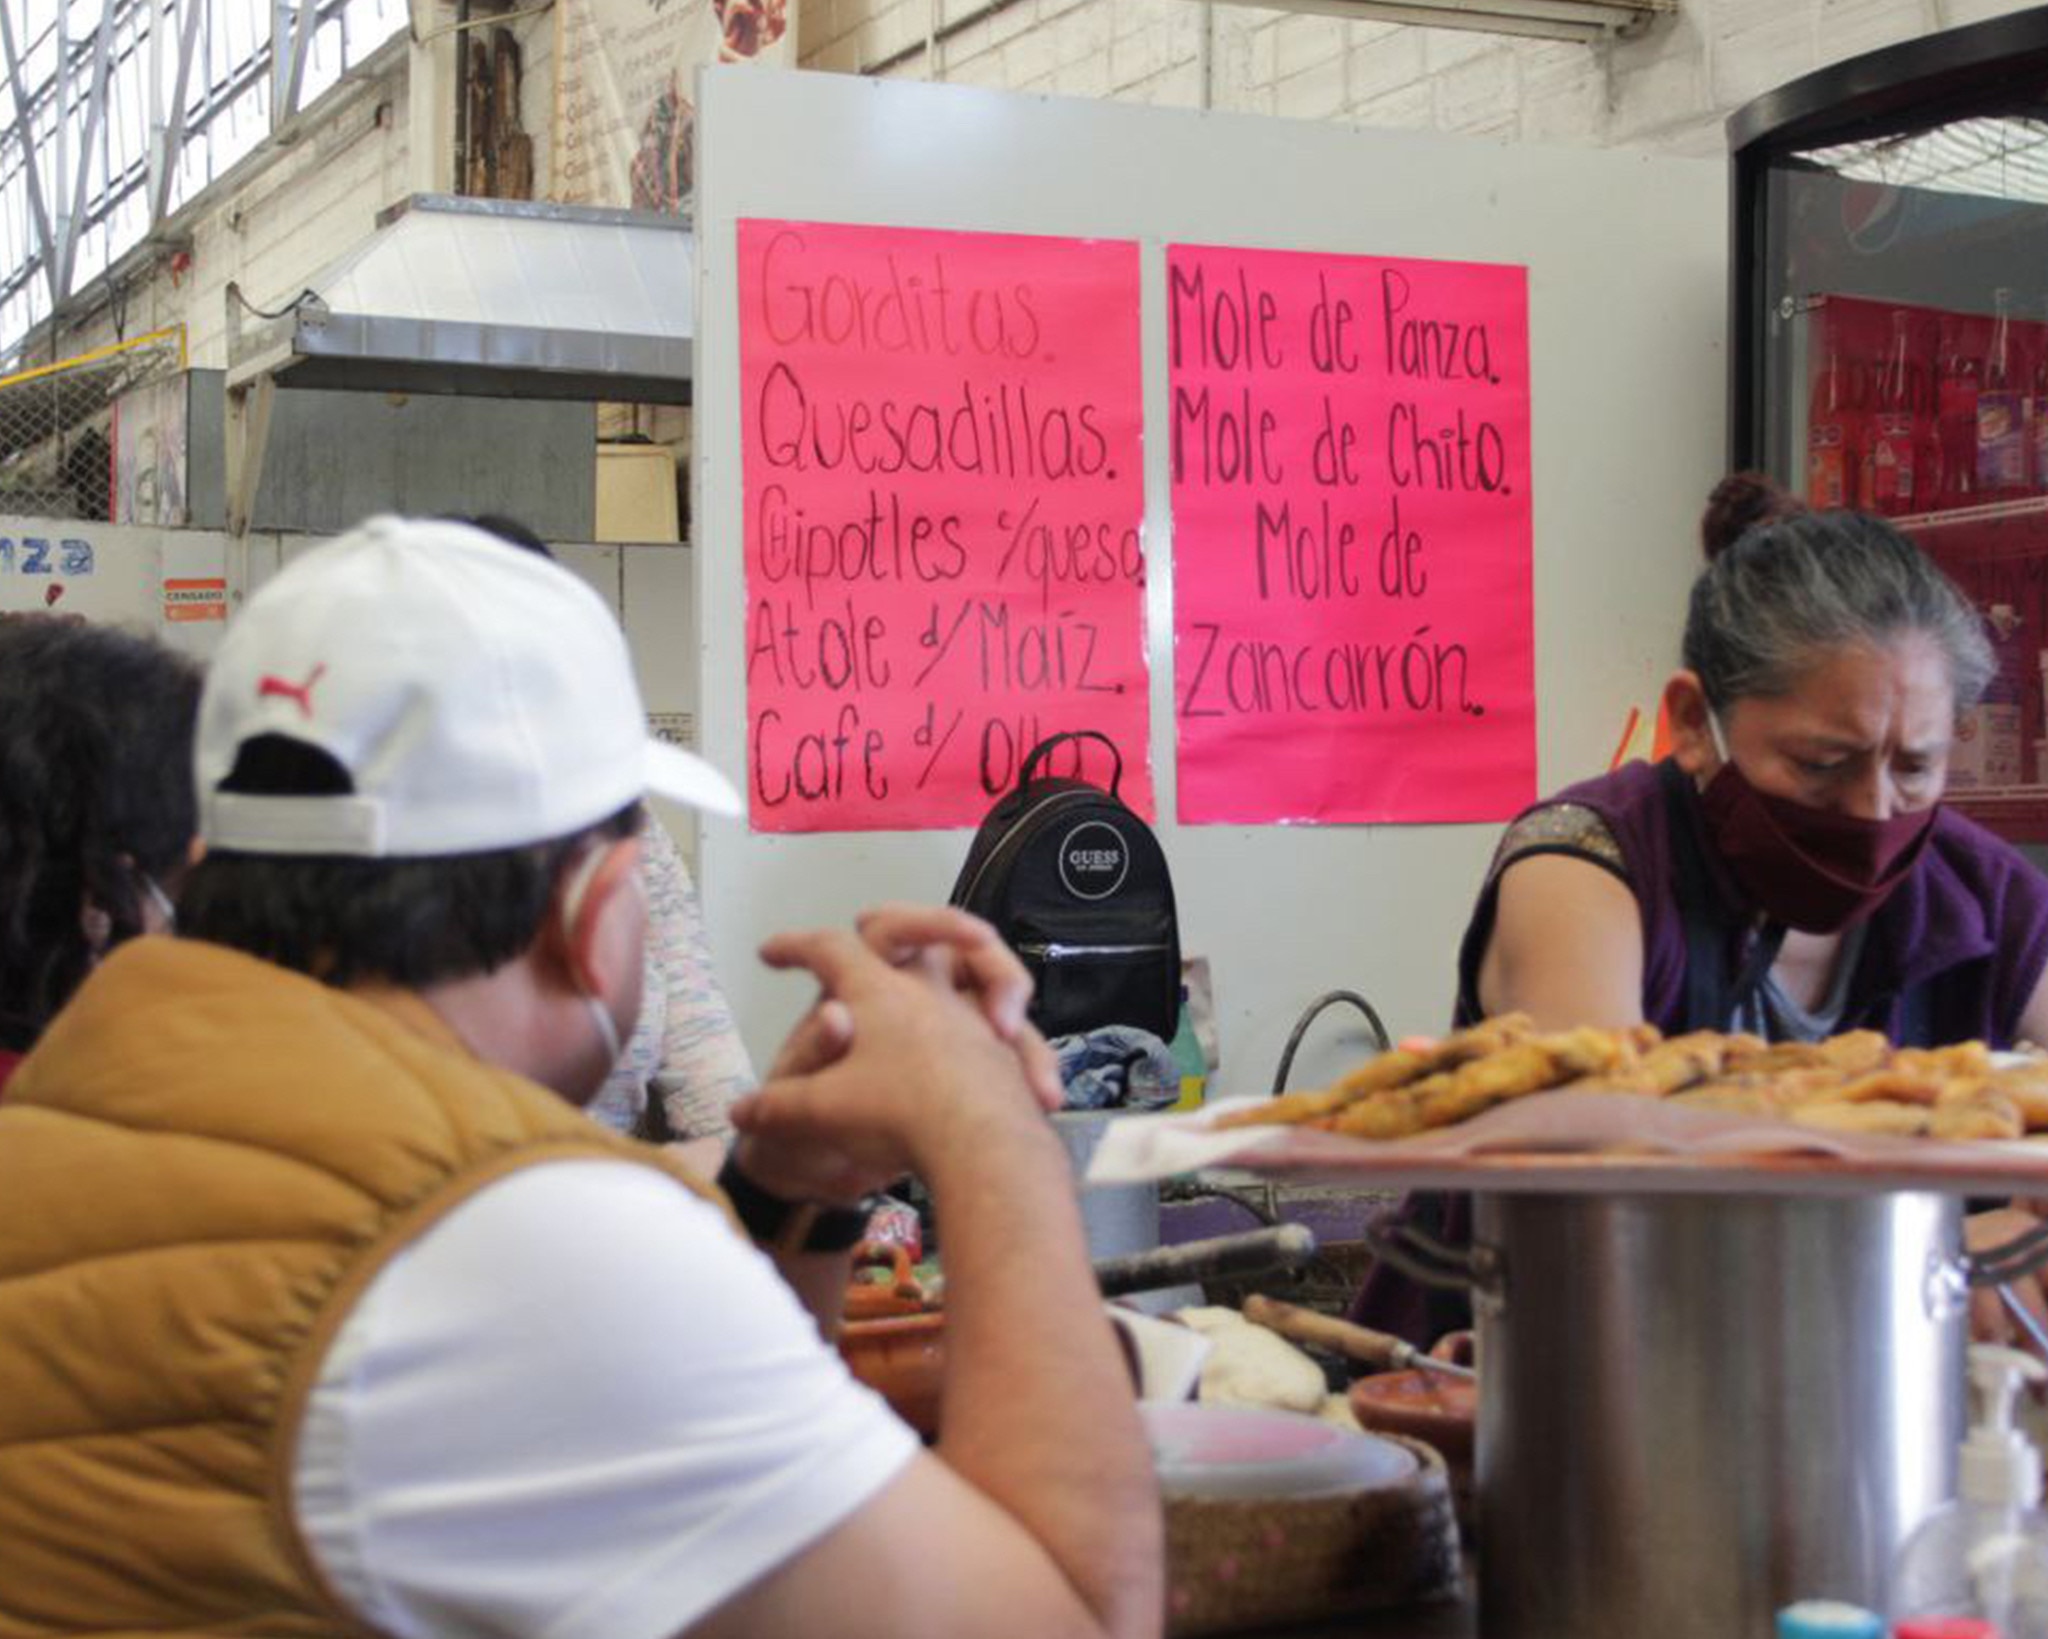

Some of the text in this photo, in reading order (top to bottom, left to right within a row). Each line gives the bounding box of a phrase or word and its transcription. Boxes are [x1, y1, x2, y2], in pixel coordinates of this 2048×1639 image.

[763, 231, 1056, 364] Gorditas.
[1171, 262, 1501, 384] Mole de Panza.
[759, 361, 1118, 481] Quesadillas.
[1173, 385, 1512, 495] Mole de Chito.
[1256, 493, 1428, 601] Mole de
[746, 599, 891, 692] Atole
[1180, 623, 1486, 718] Zancarrón.
[754, 703, 889, 807] Cafe
[1069, 849, 1120, 865] GUESS
